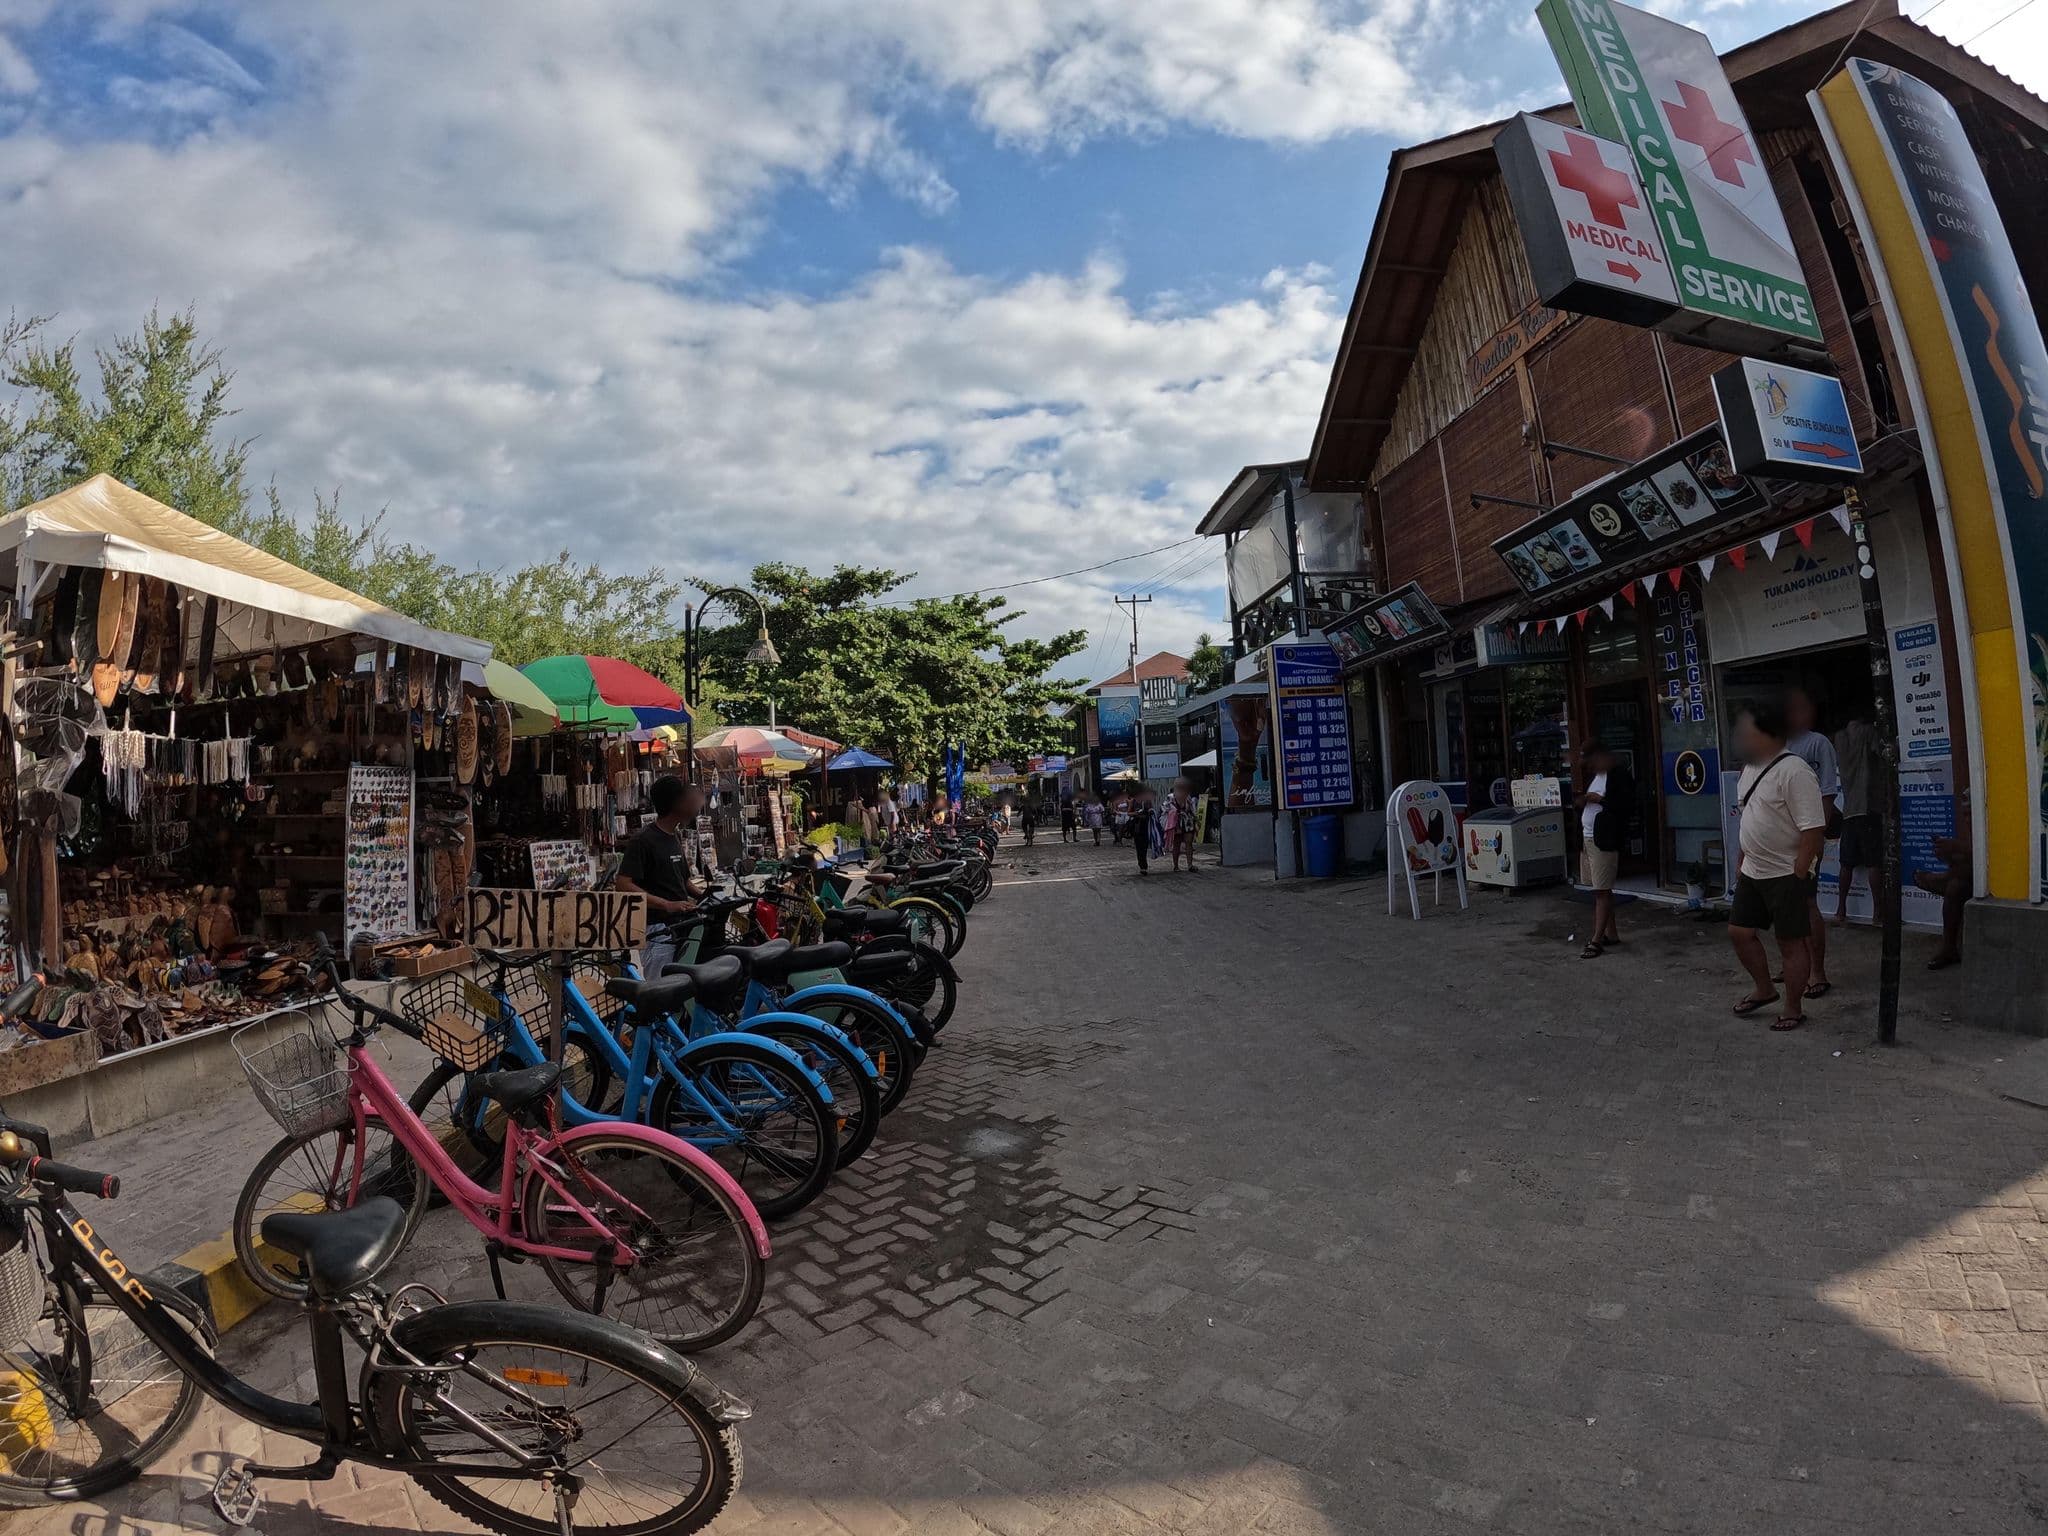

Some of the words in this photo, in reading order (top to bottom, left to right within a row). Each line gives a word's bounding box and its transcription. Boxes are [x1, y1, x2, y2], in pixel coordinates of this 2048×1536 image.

[1569, 0, 1697, 250] MEDICAL
[1566, 219, 1662, 264] MEDICAL
[1680, 263, 1813, 327] SERVICE
[1782, 415, 1812, 432] CREATIVE
[1773, 437, 1783, 448] 50
[1782, 439, 1791, 449] M
[1763, 578, 1806, 599] TUKANG
[1806, 563, 1855, 587] HOLIDAY
[1897, 627, 1932, 639] AVAILABLE
[1902, 639, 1914, 648] FOR
[1915, 636, 1932, 645] RENT
[1656, 596, 1686, 723] MONEY
[1677, 591, 1706, 722] CHANGER
[1904, 653, 1933, 664] GoPro
[1281, 675, 1306, 686] MONEY
[1296, 699, 1312, 709] USD
[1297, 712, 1313, 722] AUD
[1298, 725, 1313, 735] EUR
[1911, 728, 1926, 737] Life
[1300, 752, 1316, 762] GBP
[1302, 779, 1318, 789] SGD
[1902, 783, 1945, 793] SERVICES
[467, 889, 566, 949] RENT
[575, 892, 644, 949] BIKE
